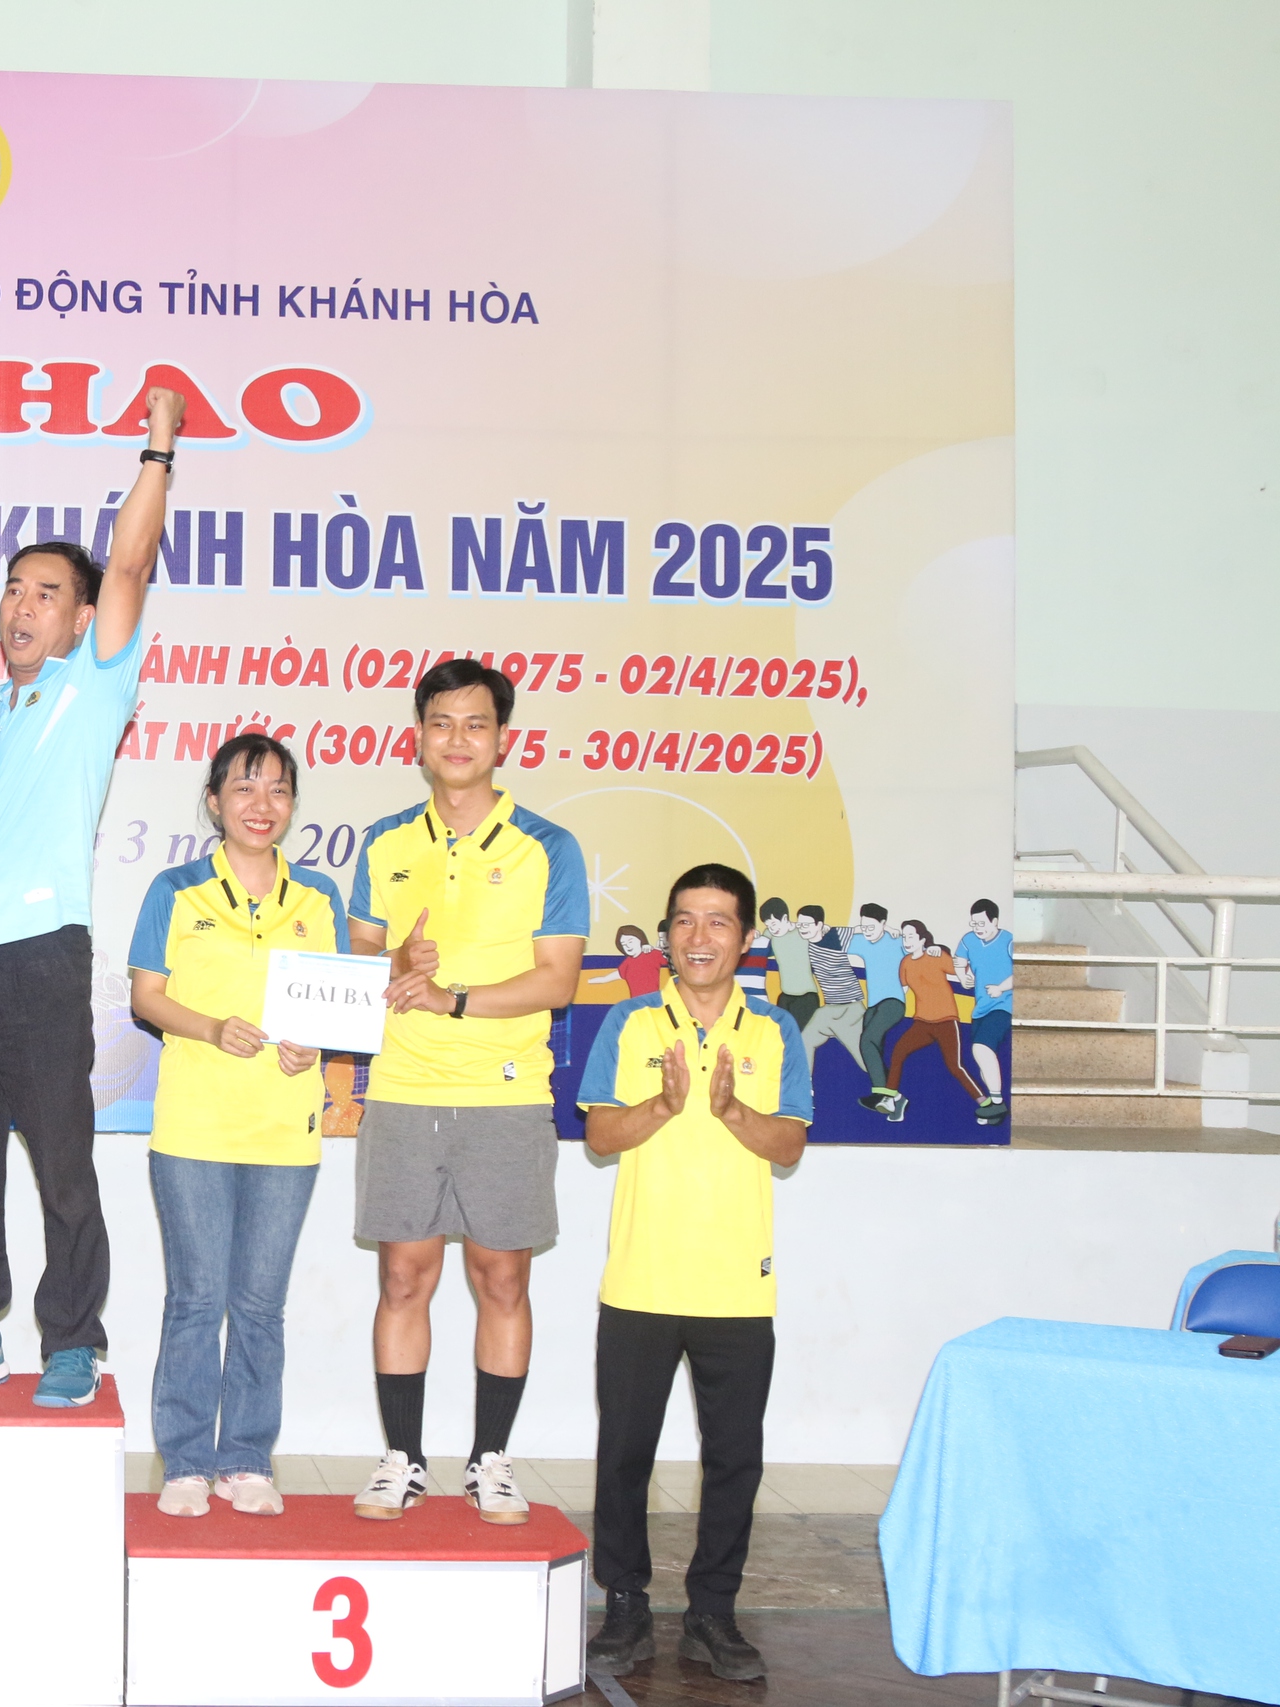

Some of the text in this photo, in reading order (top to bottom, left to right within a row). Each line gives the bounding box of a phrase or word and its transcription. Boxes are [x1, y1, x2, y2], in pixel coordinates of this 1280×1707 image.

[15, 269, 142, 319] ĐỘNG
[159, 268, 259, 317] TỈNH
[279, 278, 430, 321] KHÁNH
[449, 281, 539, 325] HÒA
[272, 494, 424, 590] HÒA
[451, 501, 625, 596] NĂM
[653, 522, 832, 601] 2025
[138, 632, 230, 685] ÁNH
[238, 635, 329, 687] HÒA
[620, 654, 868, 708] 02/4/2025),
[583, 730, 823, 780] 30/4/2025)
[118, 819, 149, 865] 3
[343, 987, 372, 1007] BA
[311, 1575, 373, 1689] 3
